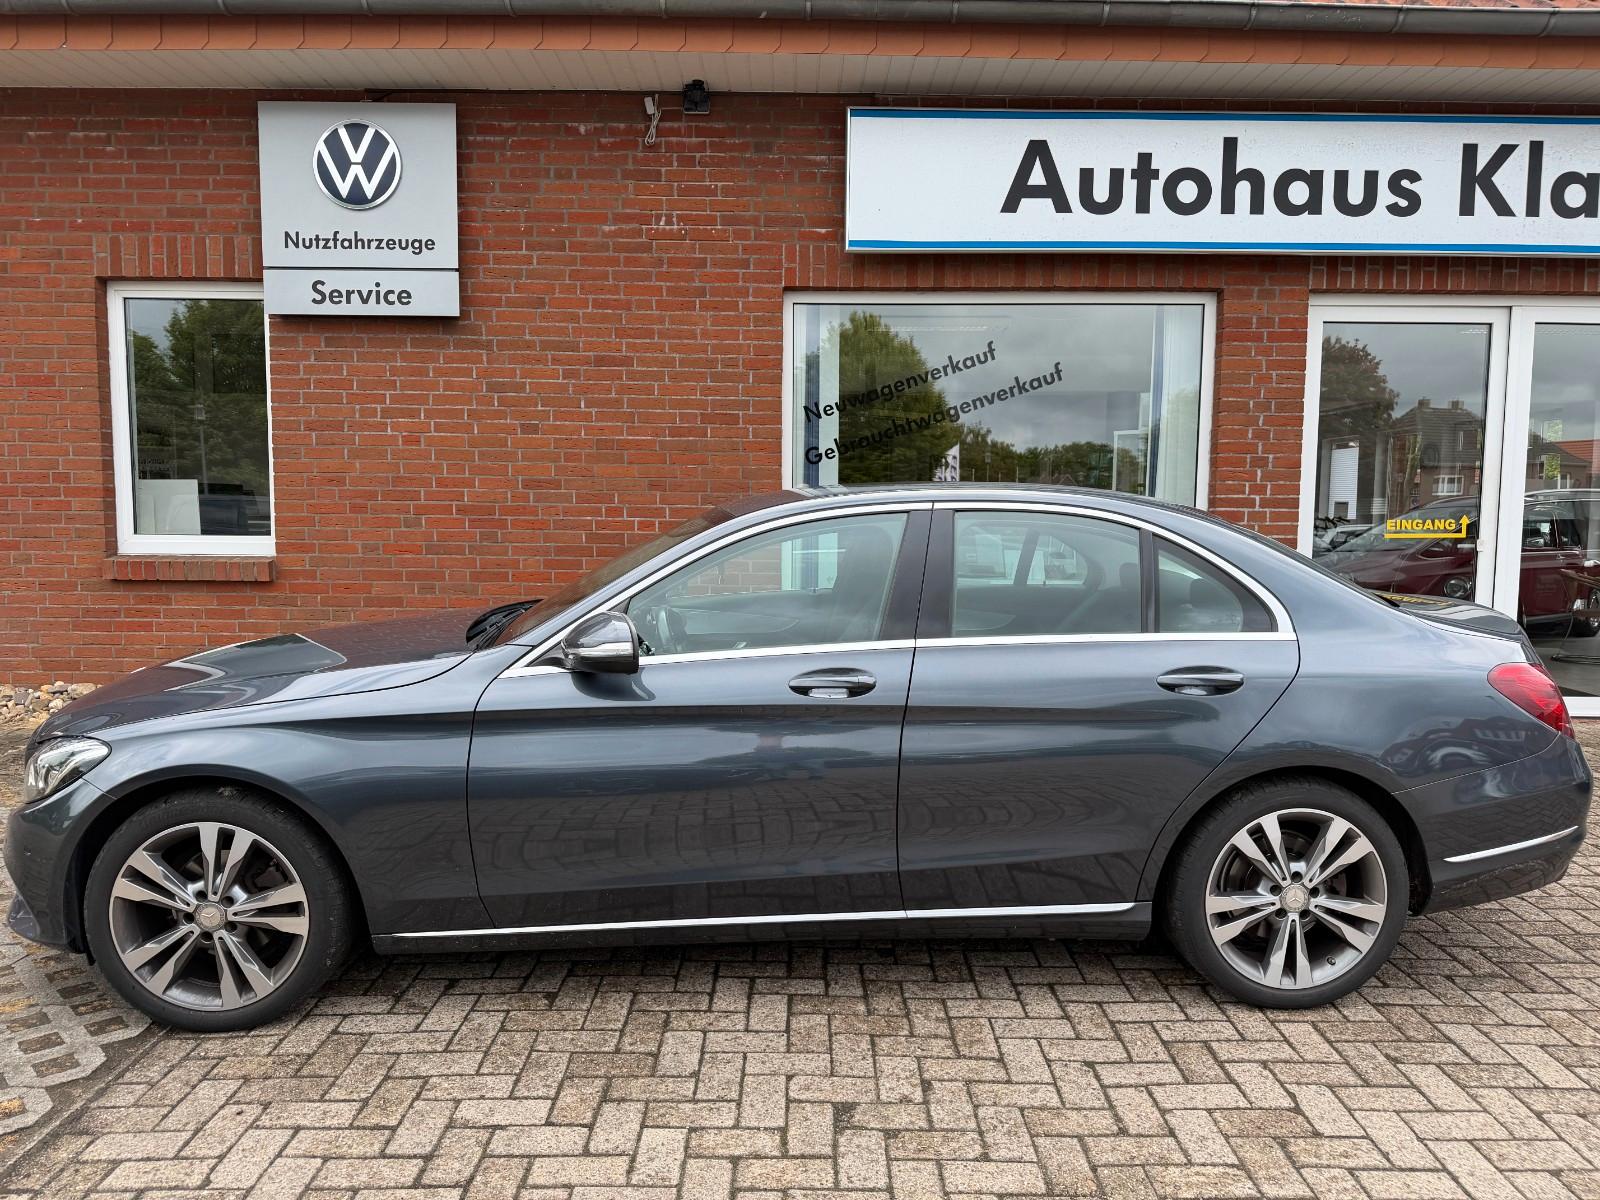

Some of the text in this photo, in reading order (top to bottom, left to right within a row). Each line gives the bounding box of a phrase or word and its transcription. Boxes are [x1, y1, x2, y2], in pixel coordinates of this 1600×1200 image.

[315, 121, 400, 206] VW
[1000, 137, 1600, 219] Autohaus Kla
[284, 230, 436, 256] Nutzfahrzeuge
[311, 279, 413, 306] Service
[803, 340, 996, 423] Neuwagenverkauf
[804, 362, 1063, 466] Gebrauchtwagenverkauf
[1386, 519, 1456, 531] EINGANG
